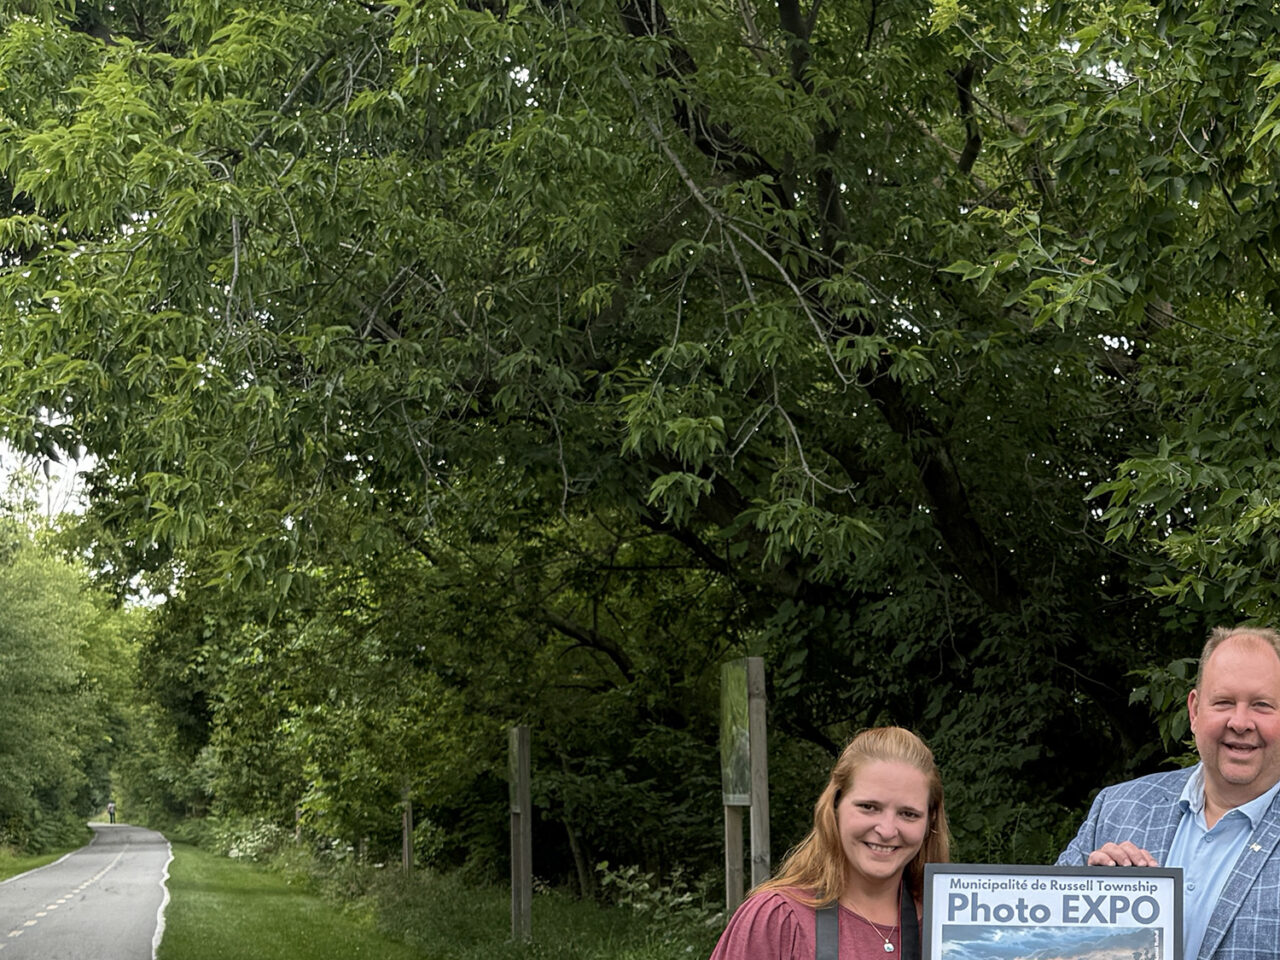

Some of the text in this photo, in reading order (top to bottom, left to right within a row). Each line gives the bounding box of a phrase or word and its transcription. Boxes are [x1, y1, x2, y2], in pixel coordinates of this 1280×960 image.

[950, 878, 1158, 895] Municipalité de Russell Township
[948, 893, 1160, 925] Photo EXPO
